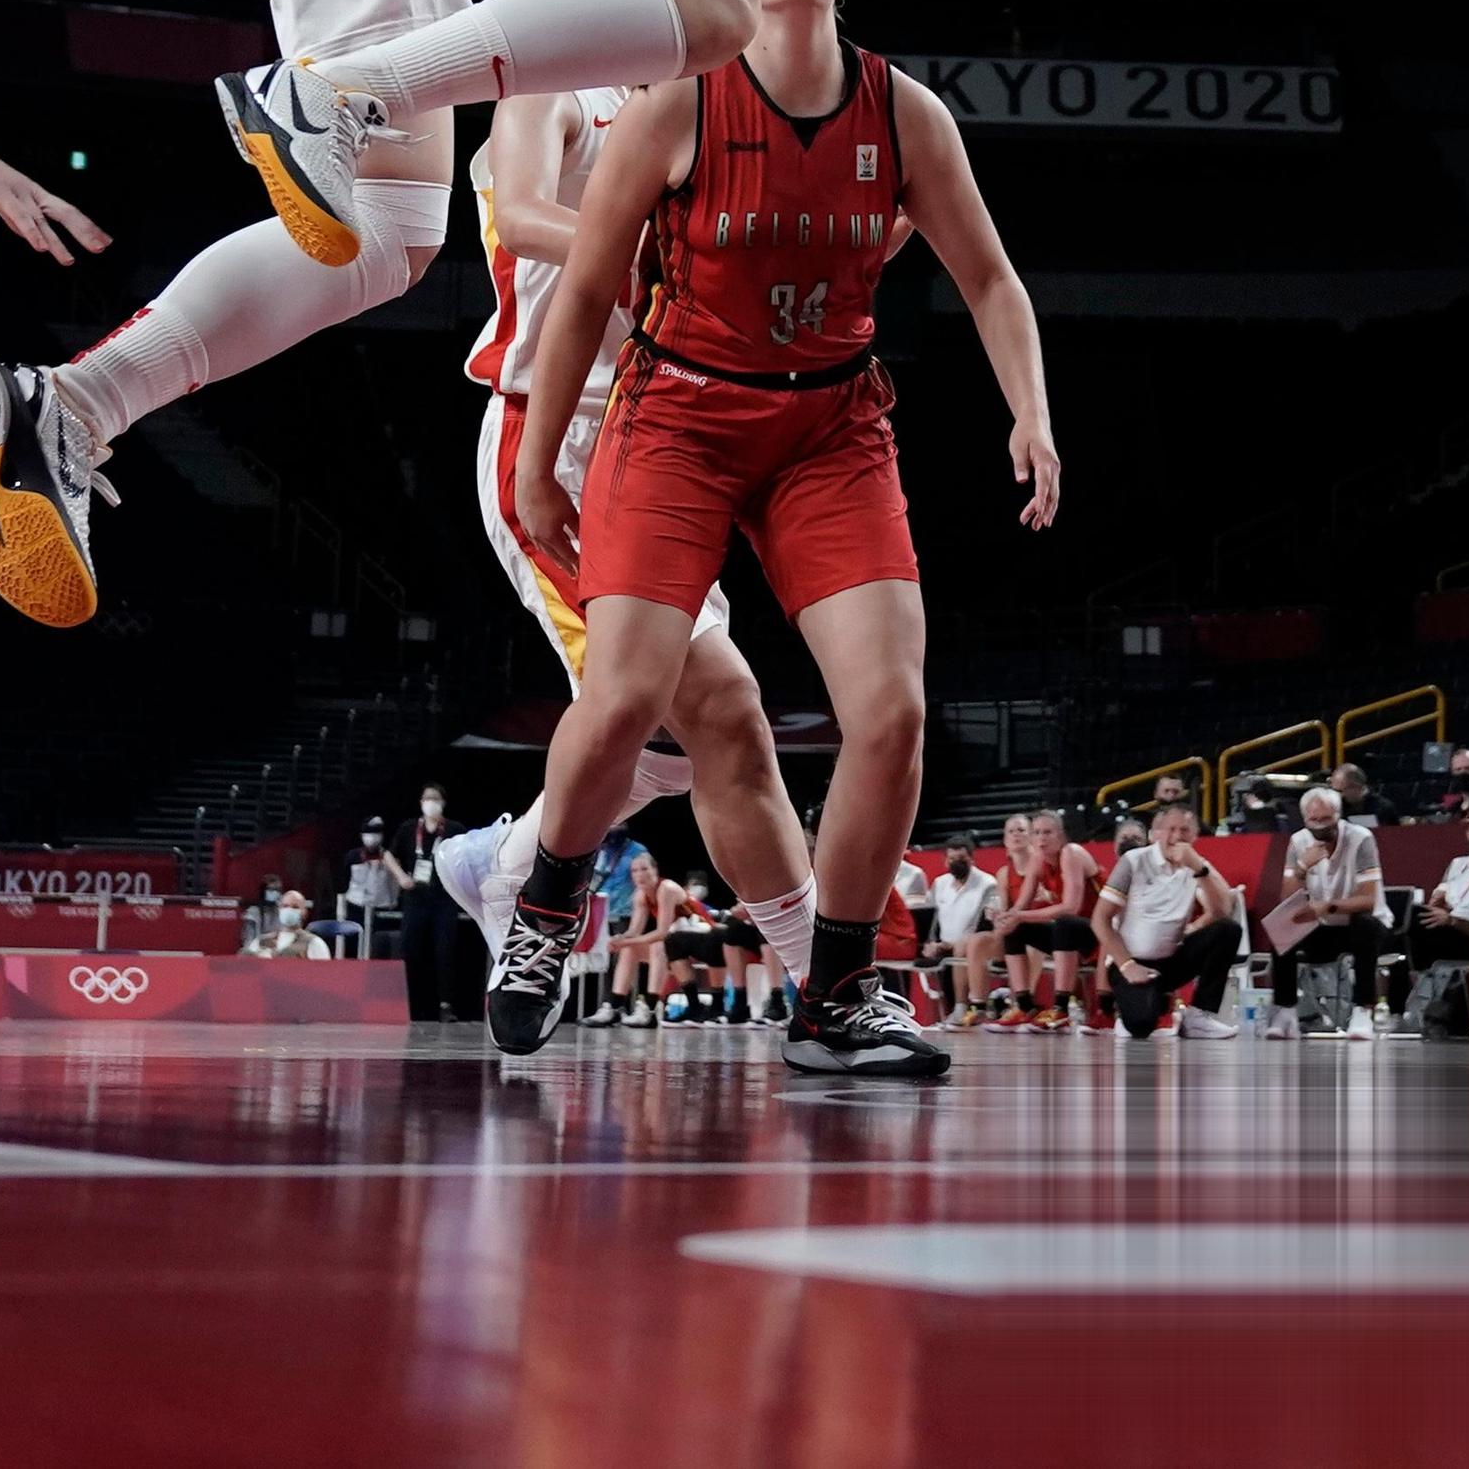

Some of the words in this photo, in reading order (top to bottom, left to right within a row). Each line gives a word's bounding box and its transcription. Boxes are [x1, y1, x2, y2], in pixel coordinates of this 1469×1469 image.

[929, 61, 1117, 118] KYO
[1125, 67, 1345, 124] 2020
[714, 211, 884, 249] BELGIUM
[768, 281, 829, 345] 34
[658, 363, 708, 388] SPALDING
[70, 872, 151, 897] 2020
